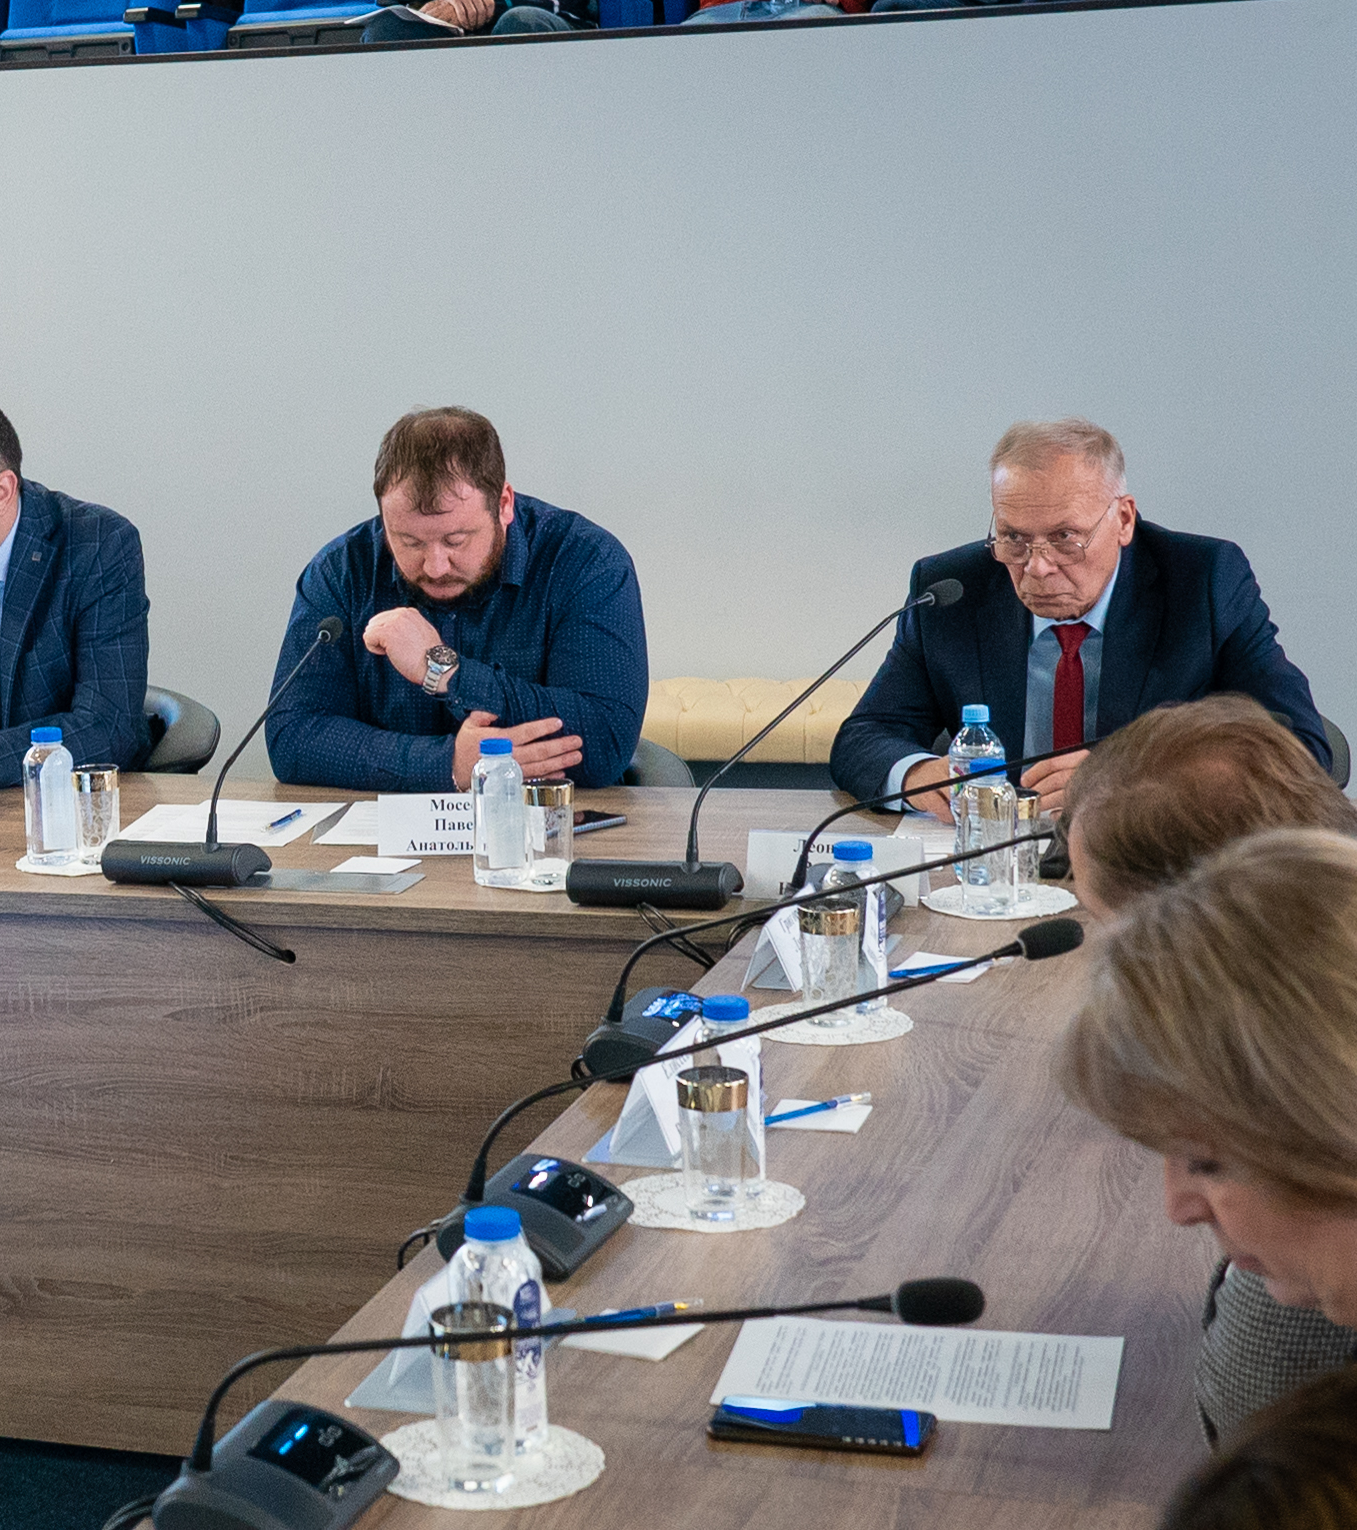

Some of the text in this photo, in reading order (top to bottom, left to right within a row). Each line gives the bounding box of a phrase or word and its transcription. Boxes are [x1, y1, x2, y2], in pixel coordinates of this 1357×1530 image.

[429, 798, 474, 812] Мосе
[434, 818, 474, 831] Паве
[405, 839, 474, 852] Анатоль
[792, 838, 835, 854] Леон
[140, 855, 192, 866] VISSONIC
[613, 878, 673, 888] VISSONIC
